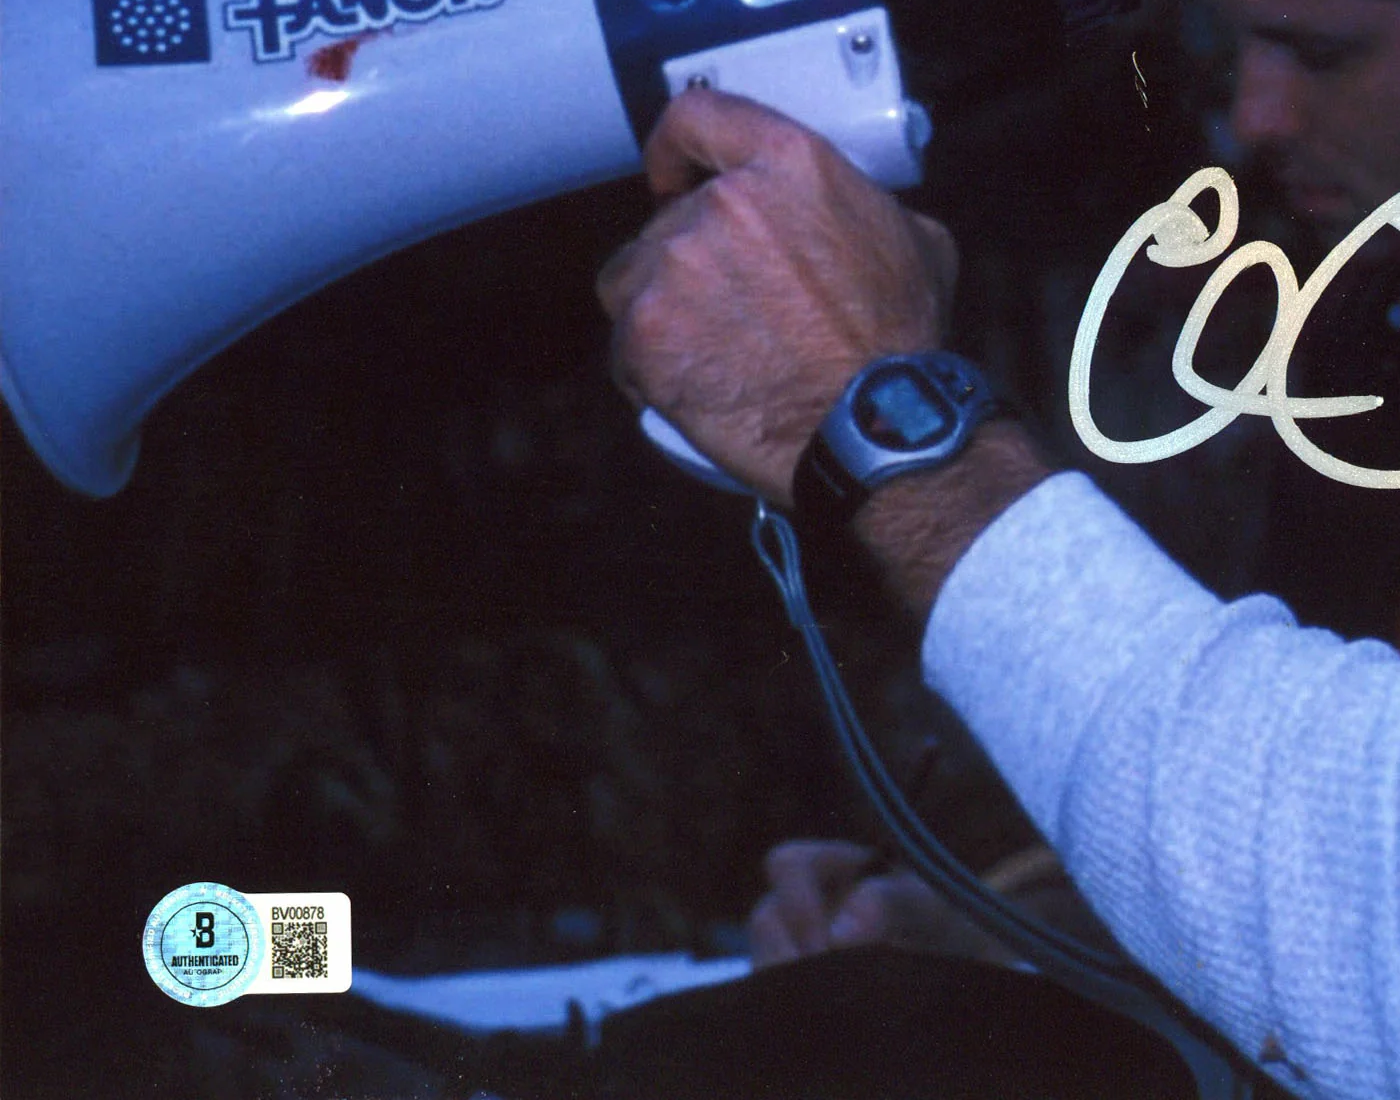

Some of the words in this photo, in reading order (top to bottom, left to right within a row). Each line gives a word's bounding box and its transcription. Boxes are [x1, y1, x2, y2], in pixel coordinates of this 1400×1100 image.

[271, 906, 325, 920] BV00878
[171, 954, 239, 967] AUTHENTICATED
[183, 968, 224, 976] AUOGRAP
